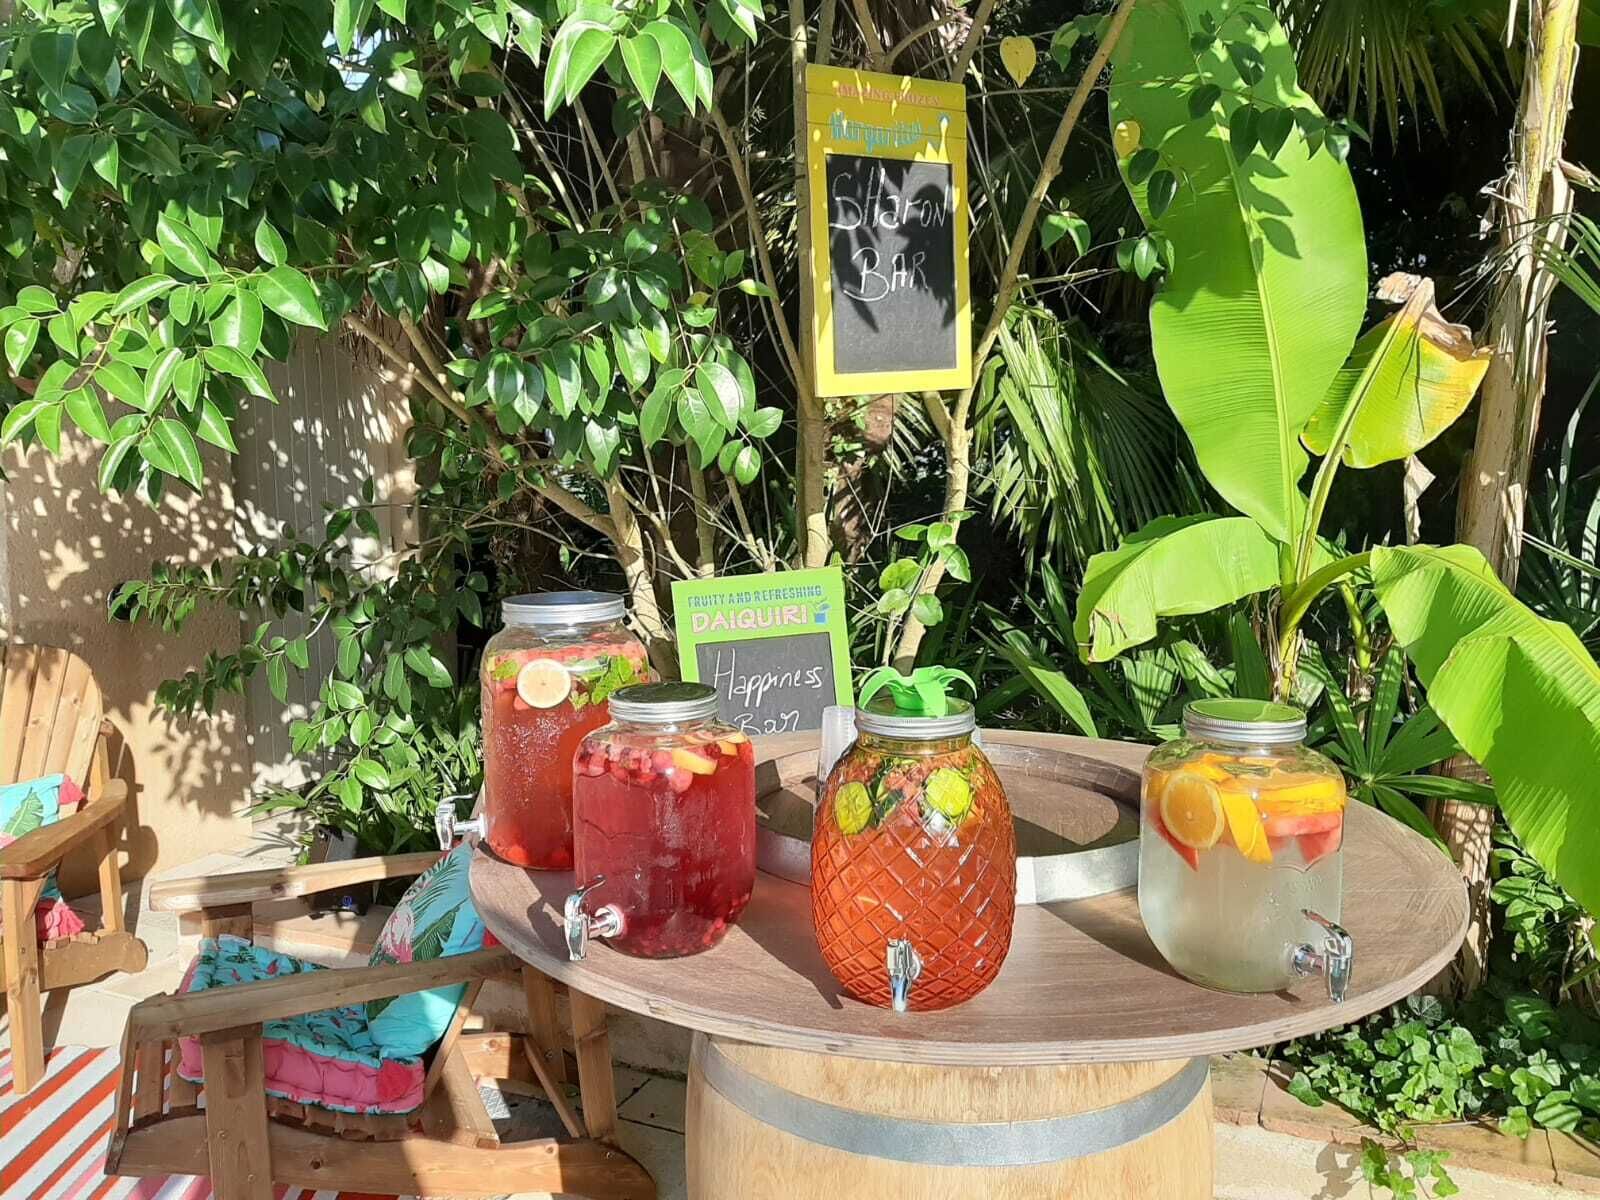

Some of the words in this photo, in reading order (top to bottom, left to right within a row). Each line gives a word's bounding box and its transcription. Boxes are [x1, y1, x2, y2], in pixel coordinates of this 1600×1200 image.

[843, 247, 929, 302] BAR
[688, 593, 725, 609] FRUITY
[728, 590, 752, 605] AND
[754, 585, 823, 603] REFRESHING
[691, 605, 808, 634] DAIQUIRI
[713, 647, 824, 708] Happiness
